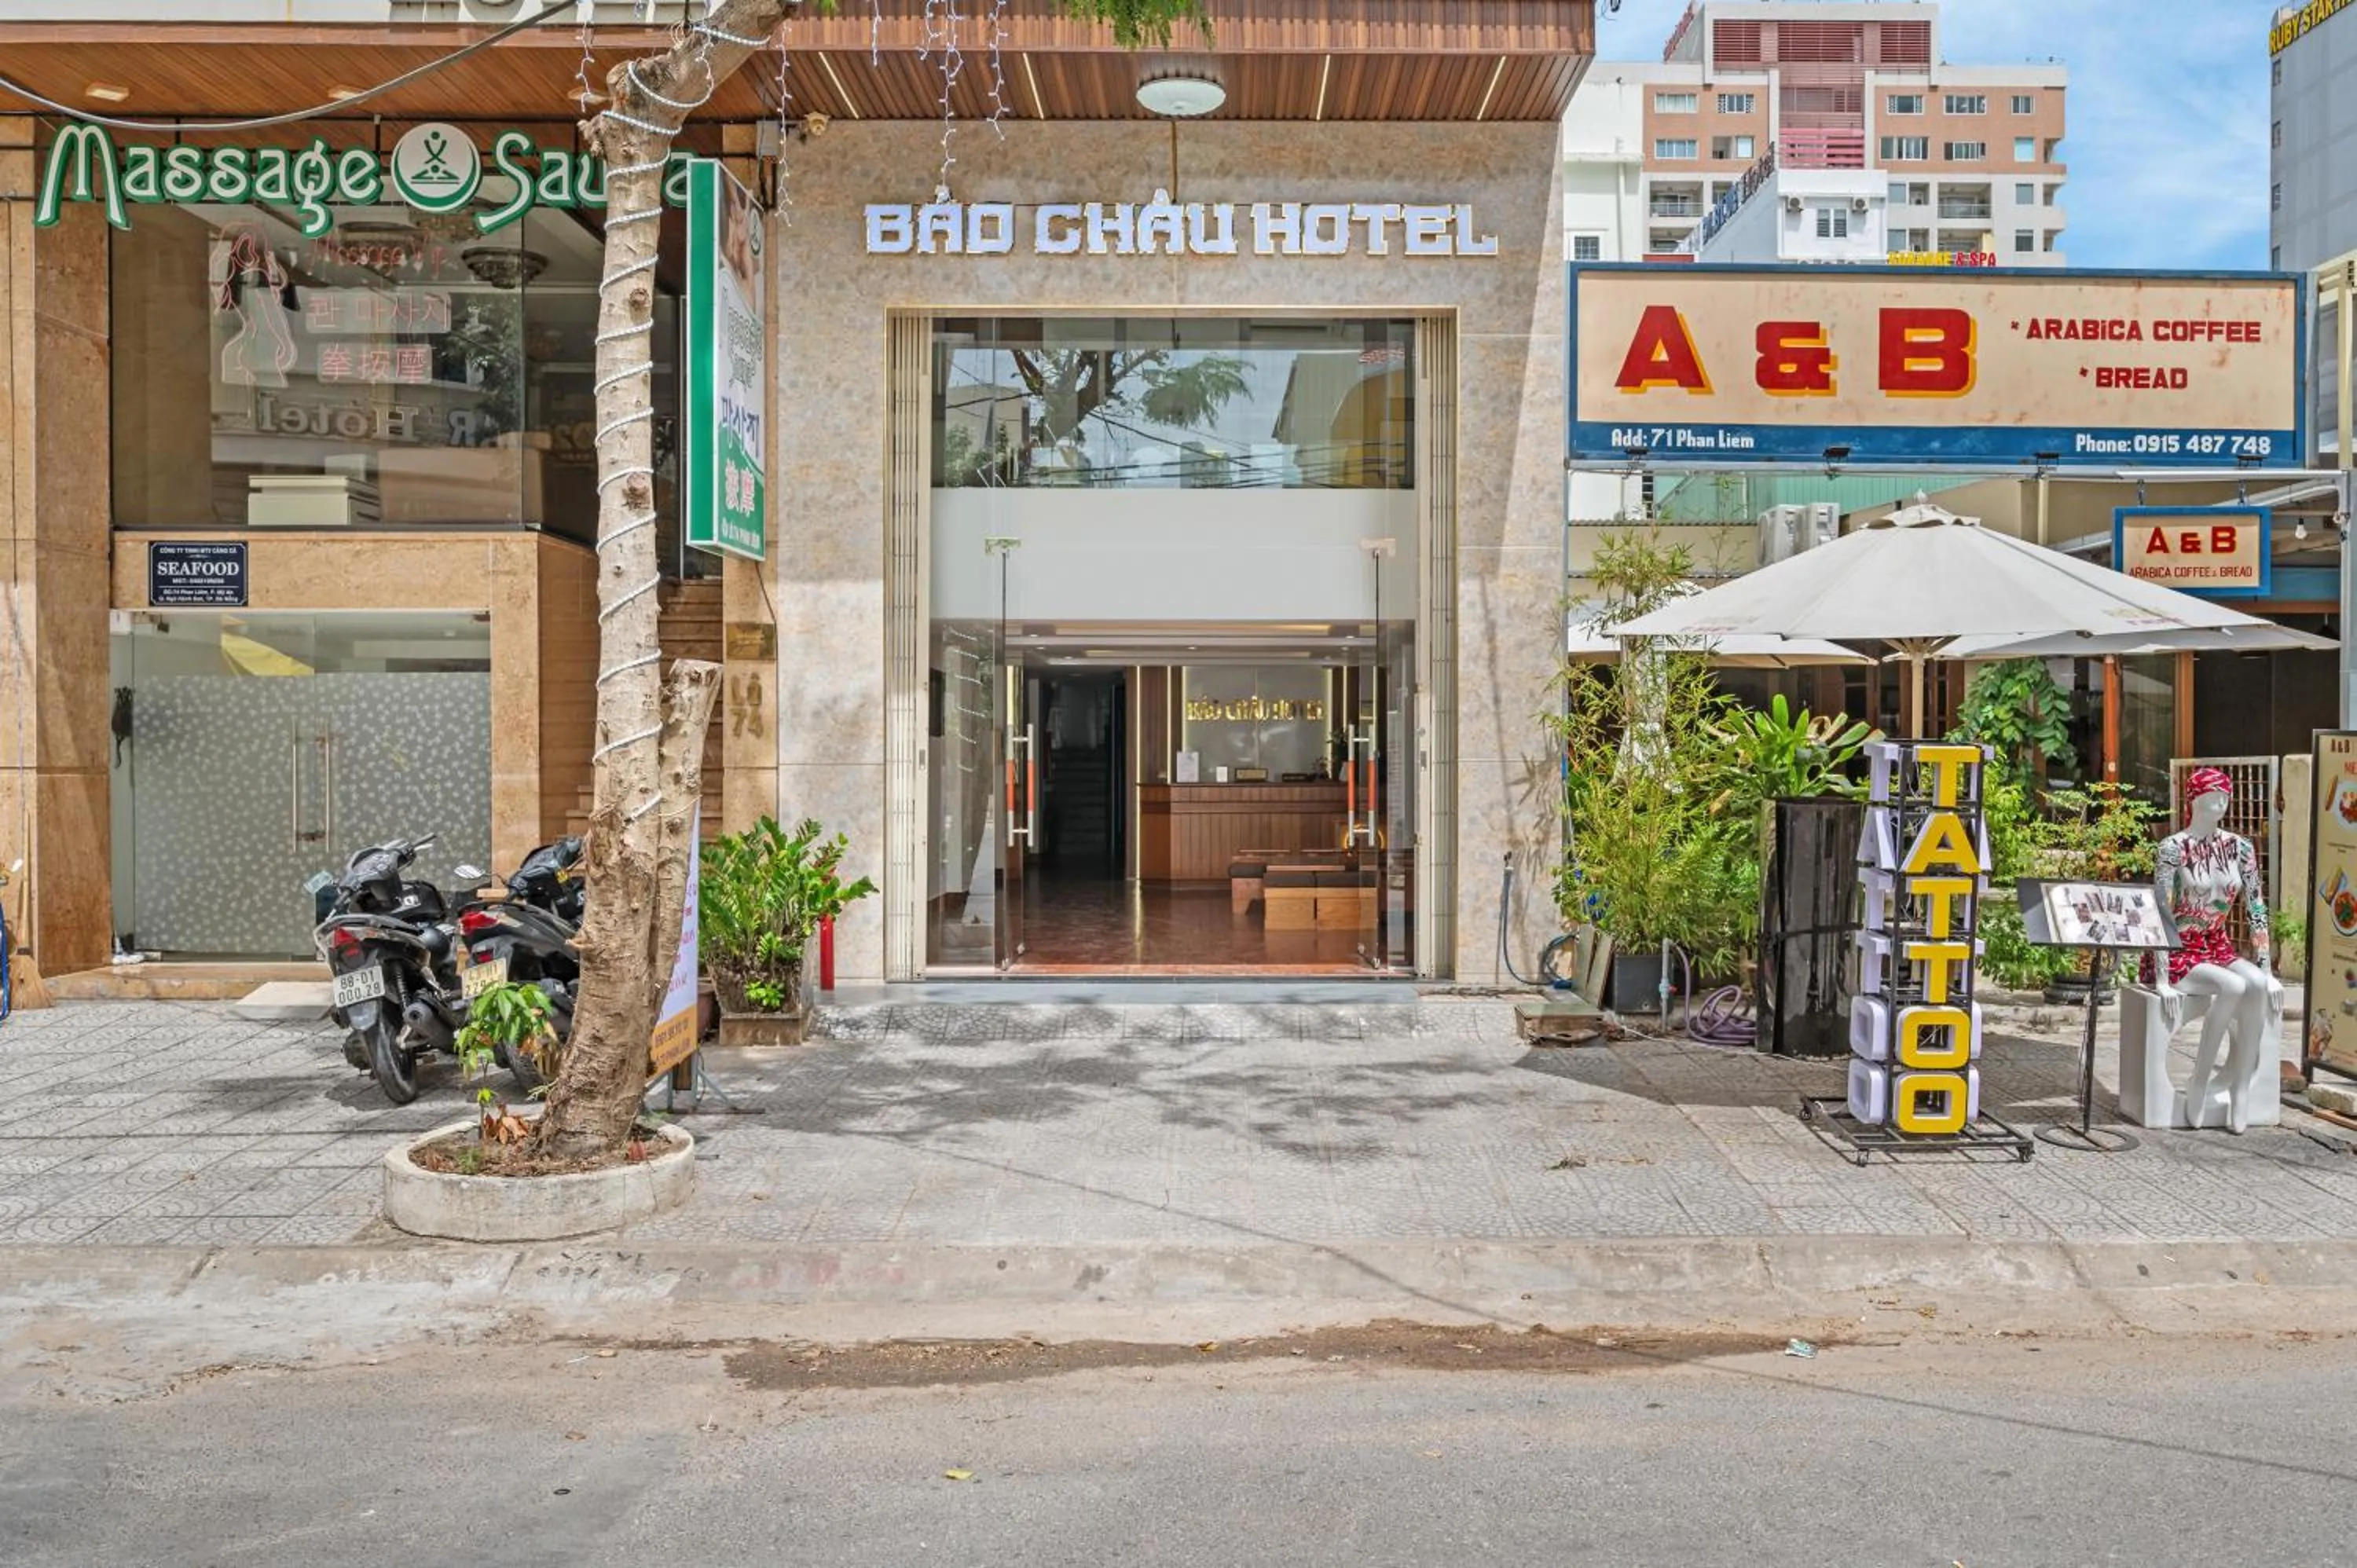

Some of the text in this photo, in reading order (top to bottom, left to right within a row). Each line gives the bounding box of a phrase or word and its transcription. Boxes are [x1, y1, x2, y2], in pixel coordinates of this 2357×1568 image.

[35, 123, 687, 234] Massage Saua
[1251, 203, 1498, 255] HOTEL
[1970, 251, 1996, 267] SPA
[2153, 320, 2262, 343] COFFEE
[1615, 306, 1978, 398] A & B
[2095, 367, 2188, 389] BREAD
[1611, 428, 1754, 448] Add: 71 Phan Liem
[2075, 433, 2271, 455] Phone: 0915 487 748
[2146, 525, 2237, 554] A & B
[157, 562, 240, 576] SEAFOOD
[2128, 566, 2172, 579] ARABICA
[2174, 566, 2210, 578] COFFEE
[2220, 566, 2253, 578] BREAD
[1893, 745, 1983, 1134] TATTOO
